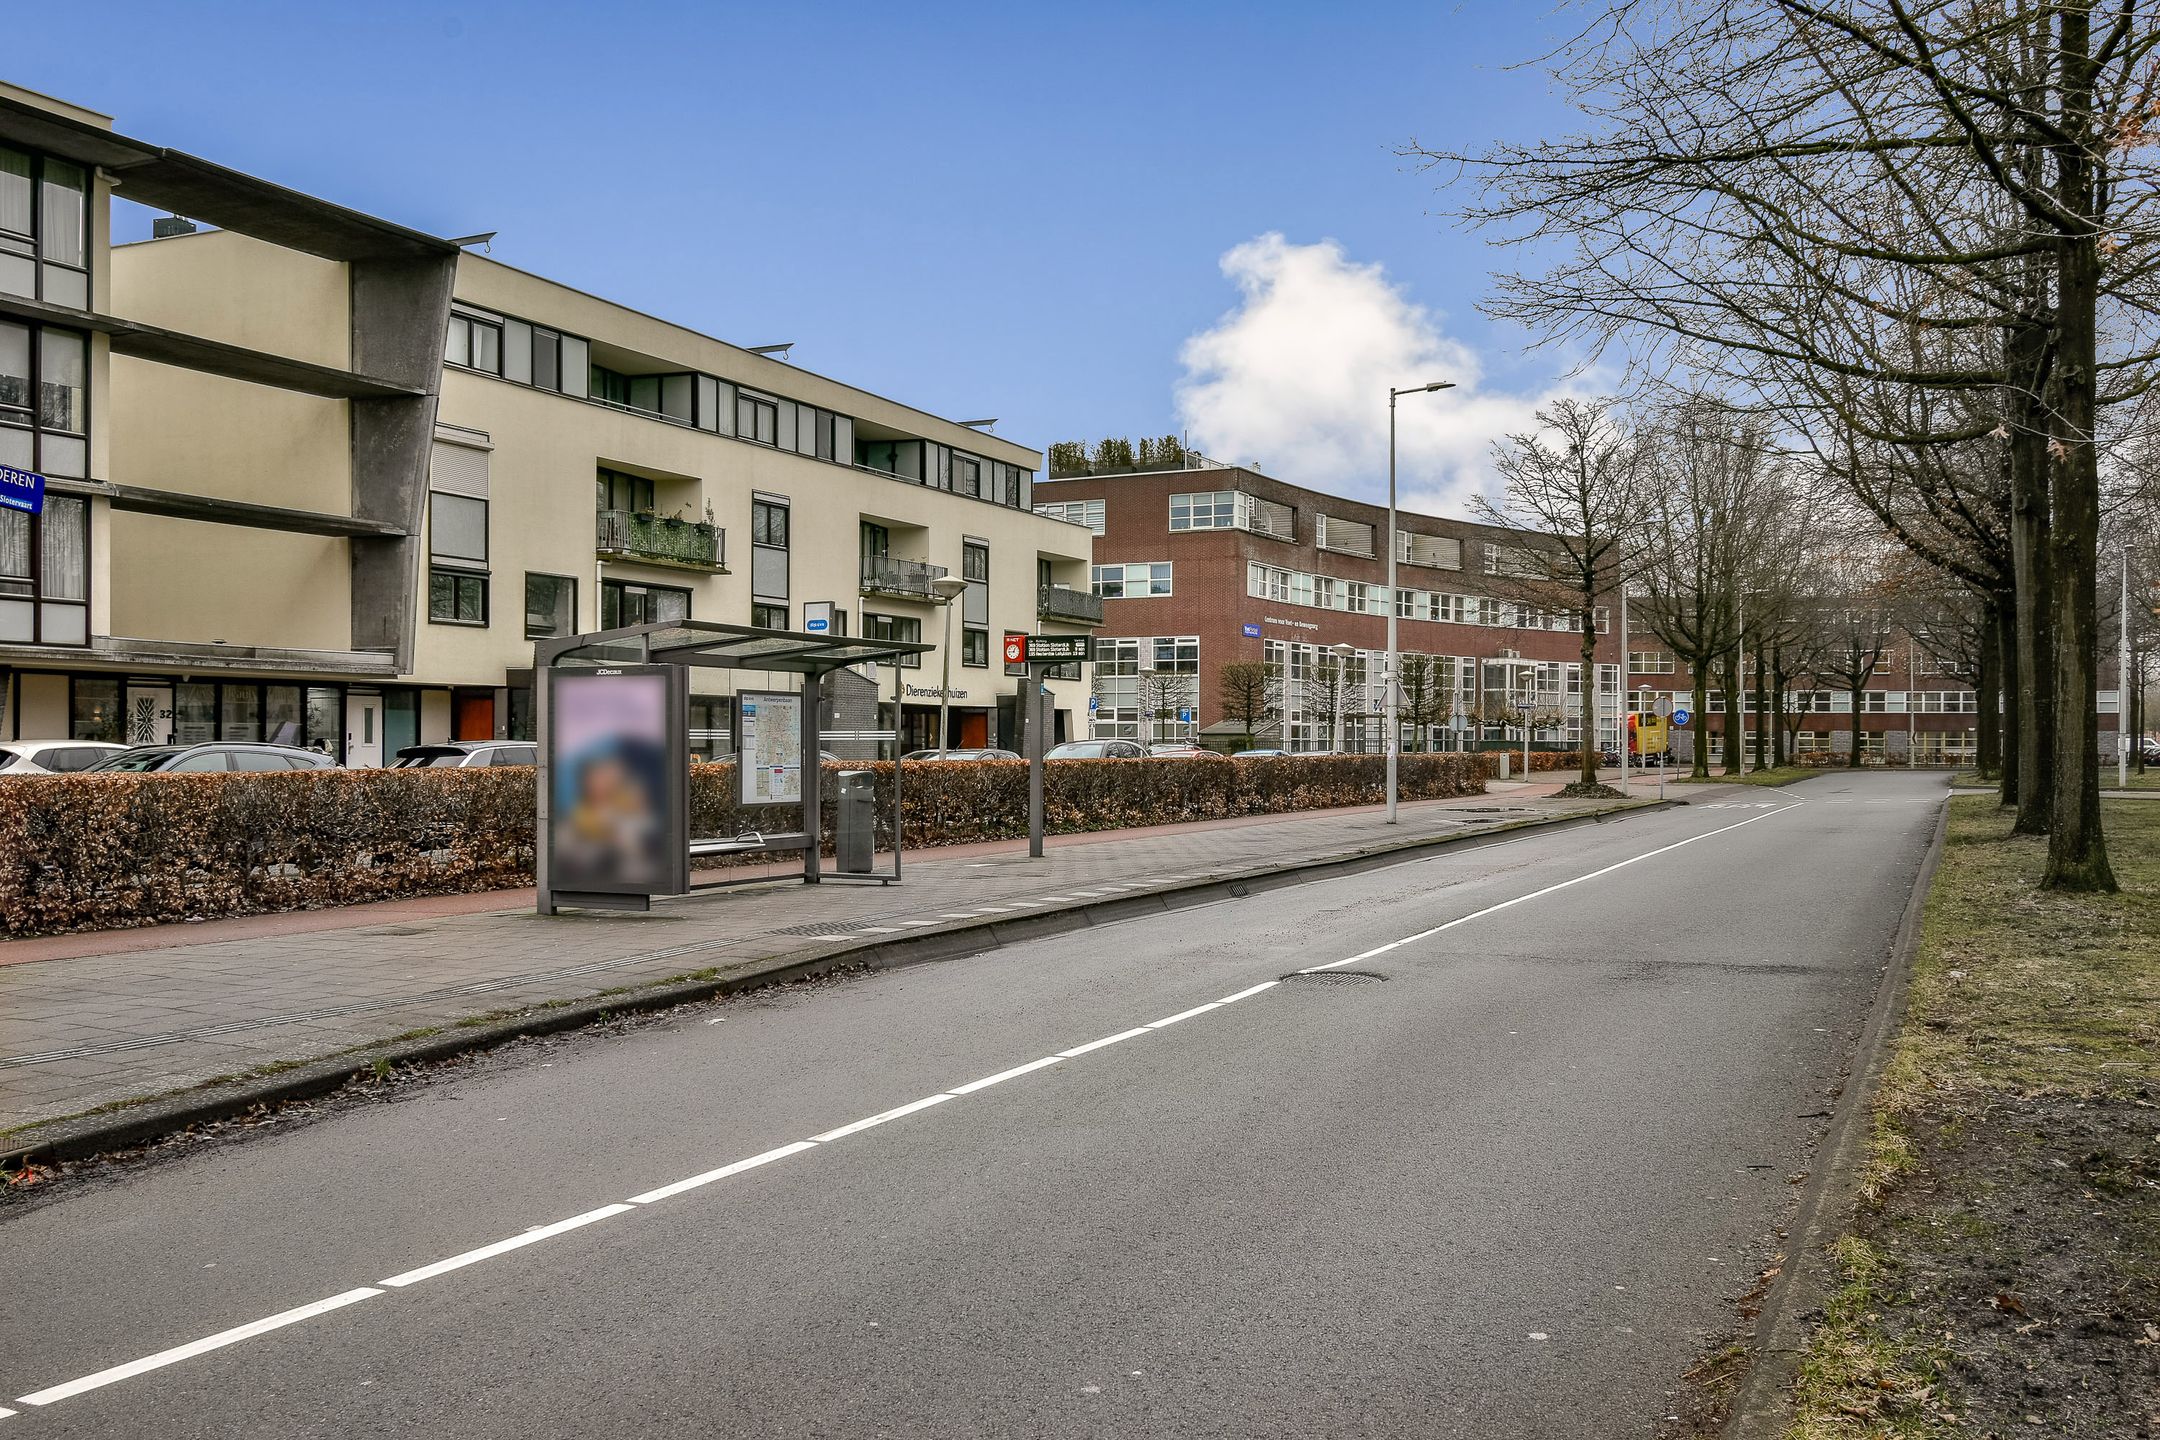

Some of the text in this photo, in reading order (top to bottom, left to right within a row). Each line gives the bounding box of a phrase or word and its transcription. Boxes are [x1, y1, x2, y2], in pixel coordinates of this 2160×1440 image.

[0, 494, 33, 510] Slotervaart
[906, 683, 967, 699] Dierenziekehuizen
[159, 709, 172, 719] 32
